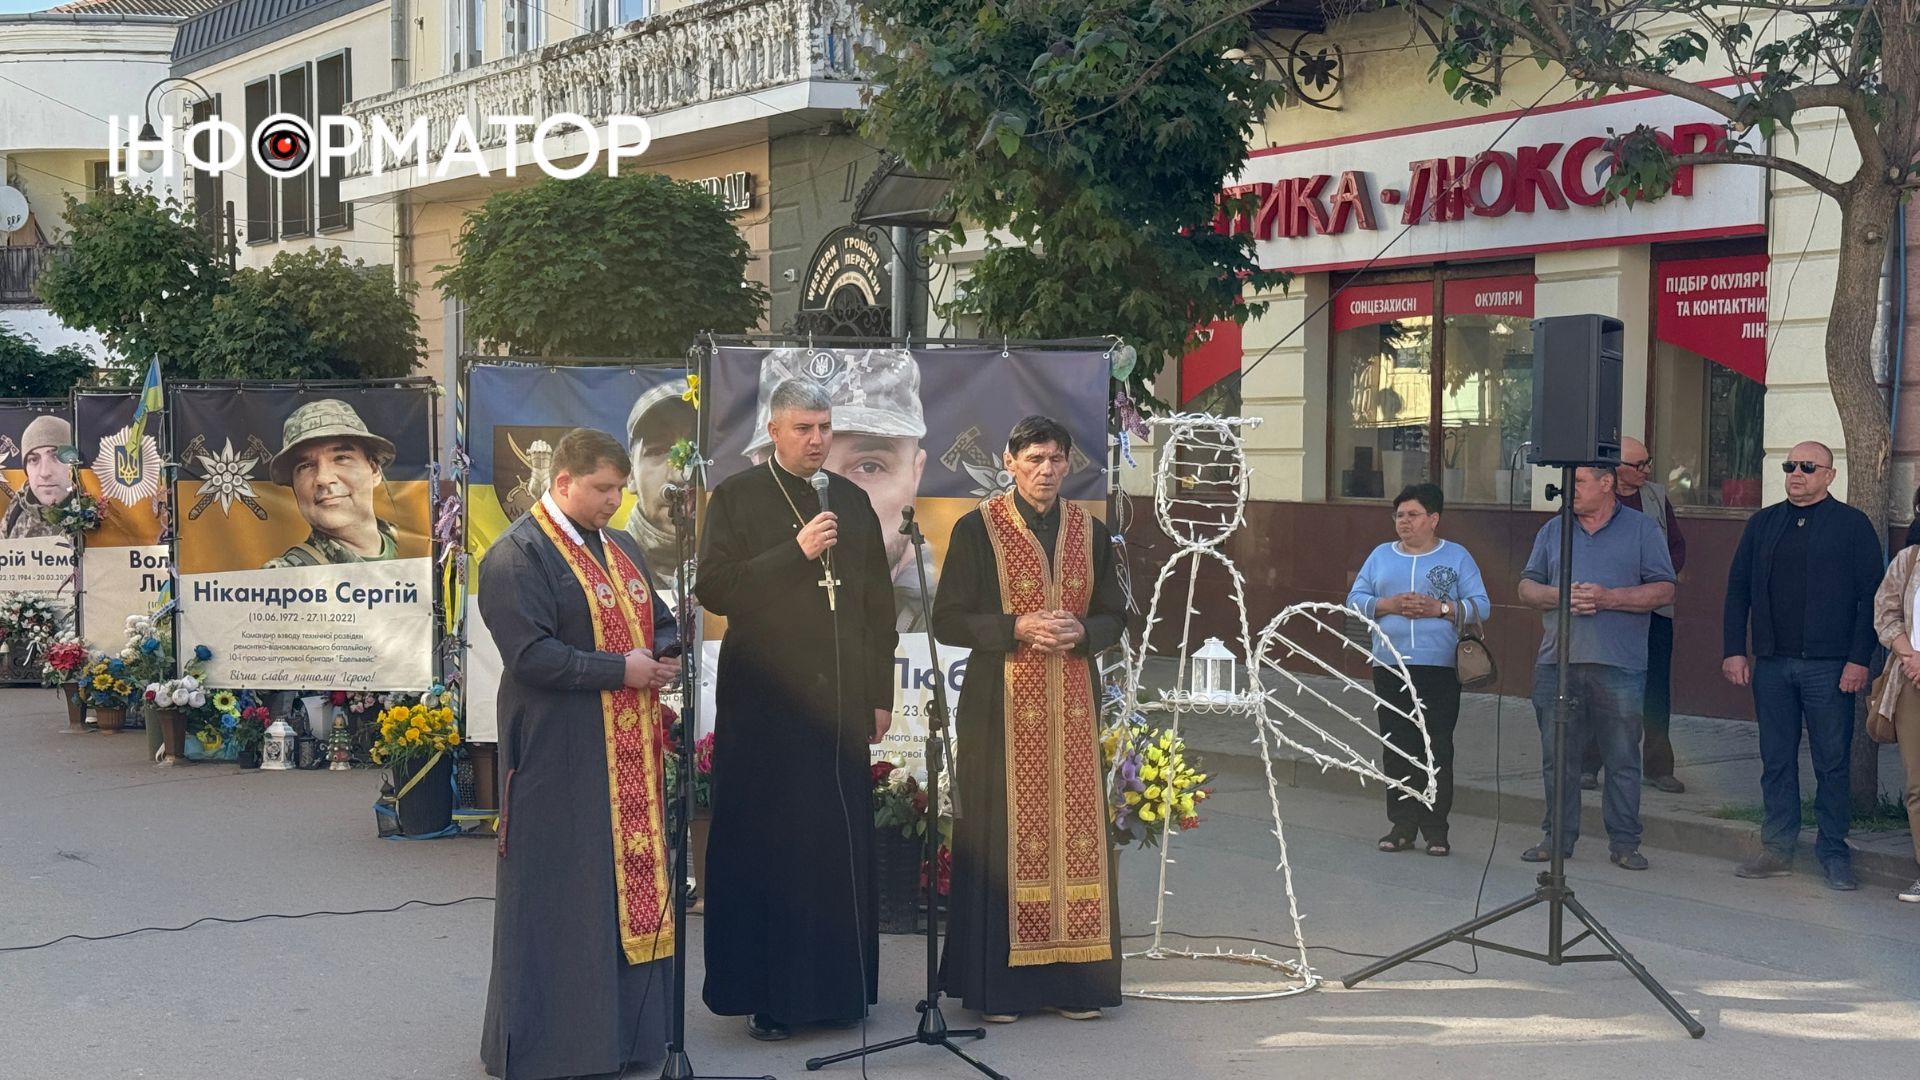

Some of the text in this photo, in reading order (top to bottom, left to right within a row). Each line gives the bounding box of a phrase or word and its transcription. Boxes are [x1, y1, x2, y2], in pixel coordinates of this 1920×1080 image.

[844, 237, 879, 267] ГРОШОВІ
[807, 245, 837, 301] WESTERN
[818, 259, 840, 295] UNION
[844, 253, 881, 295] ПЕРЕКАЗИ
[1665, 275, 1708, 295] ПІДБІР
[1350, 290, 1522, 315] СОНЦЕЗАХИСНІ ОКУЛЯРИ
[1677, 300, 1690, 316] ТА
[194, 581, 418, 609] Нікандров Сергій
[249, 613, 299, 622] (10.06.1972
[307, 613, 356, 623] 27.11.2022)
[241, 631, 275, 641] Командир
[277, 633, 300, 641] взводу
[305, 653, 334, 663] бригади
[230, 669, 256, 681] Вічна
[261, 669, 289, 681] слава
